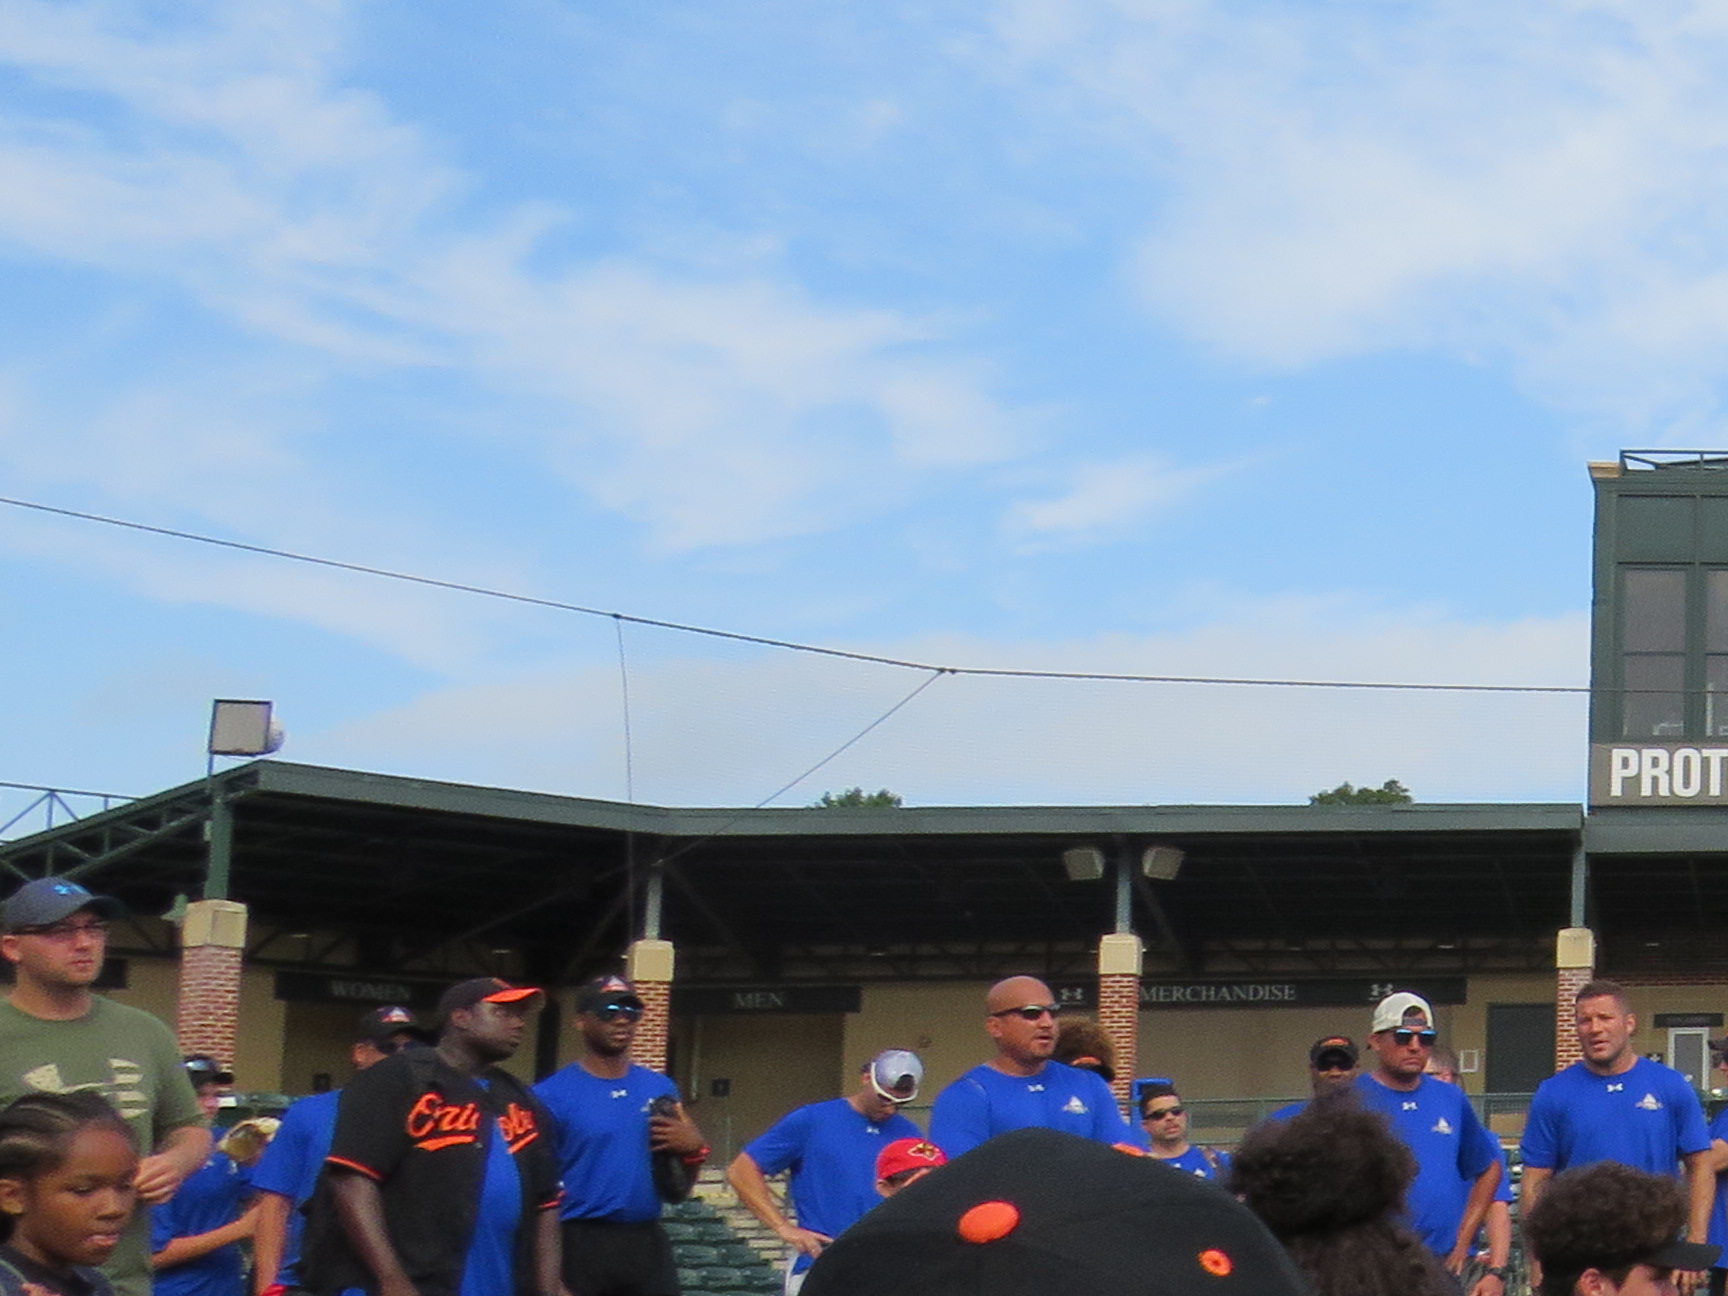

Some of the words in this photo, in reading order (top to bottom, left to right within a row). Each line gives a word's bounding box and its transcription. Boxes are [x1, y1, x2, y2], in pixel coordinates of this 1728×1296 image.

[331, 980, 411, 1002] WOMEN
[734, 991, 783, 1009] MEN
[1140, 984, 1297, 1002] MERCHANDISE
